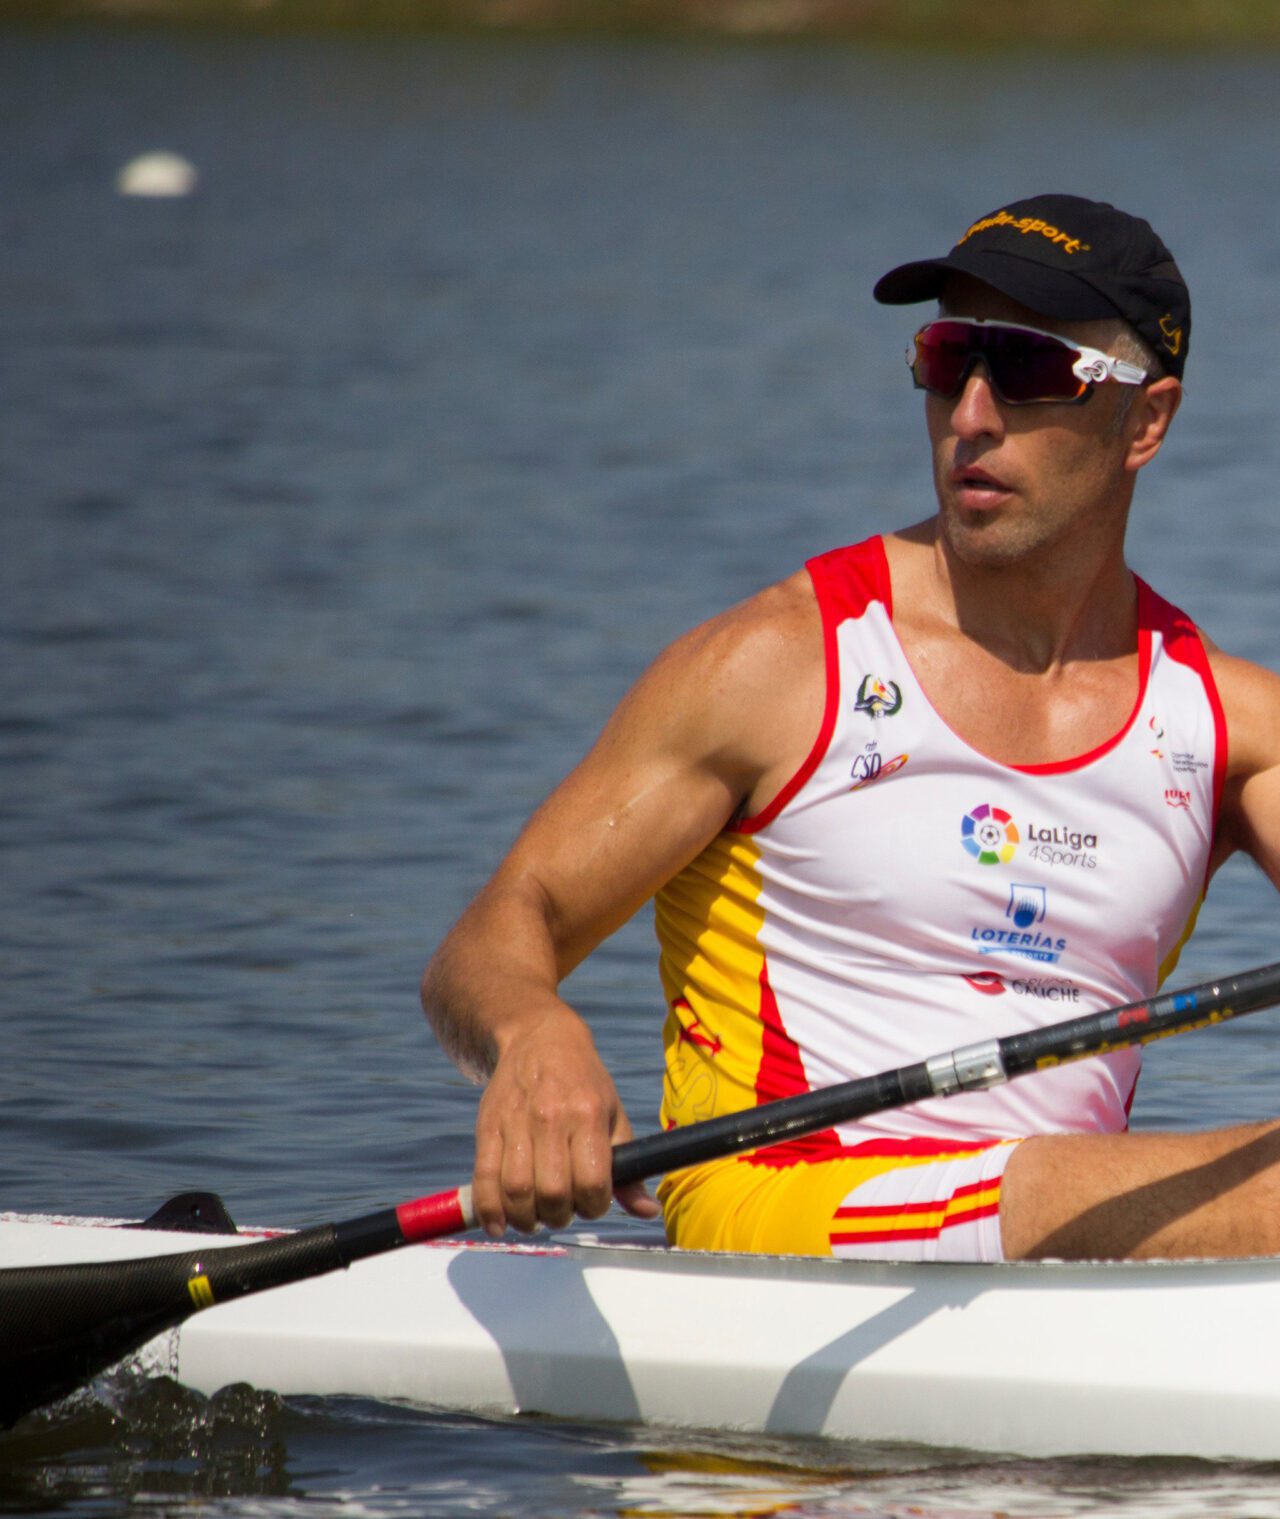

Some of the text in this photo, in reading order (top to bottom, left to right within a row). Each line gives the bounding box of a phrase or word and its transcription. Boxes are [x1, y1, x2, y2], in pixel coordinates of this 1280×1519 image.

[851, 752, 882, 781] CSD
[1028, 824, 1098, 850] LaLiga
[1028, 845, 1098, 869] 4Sports
